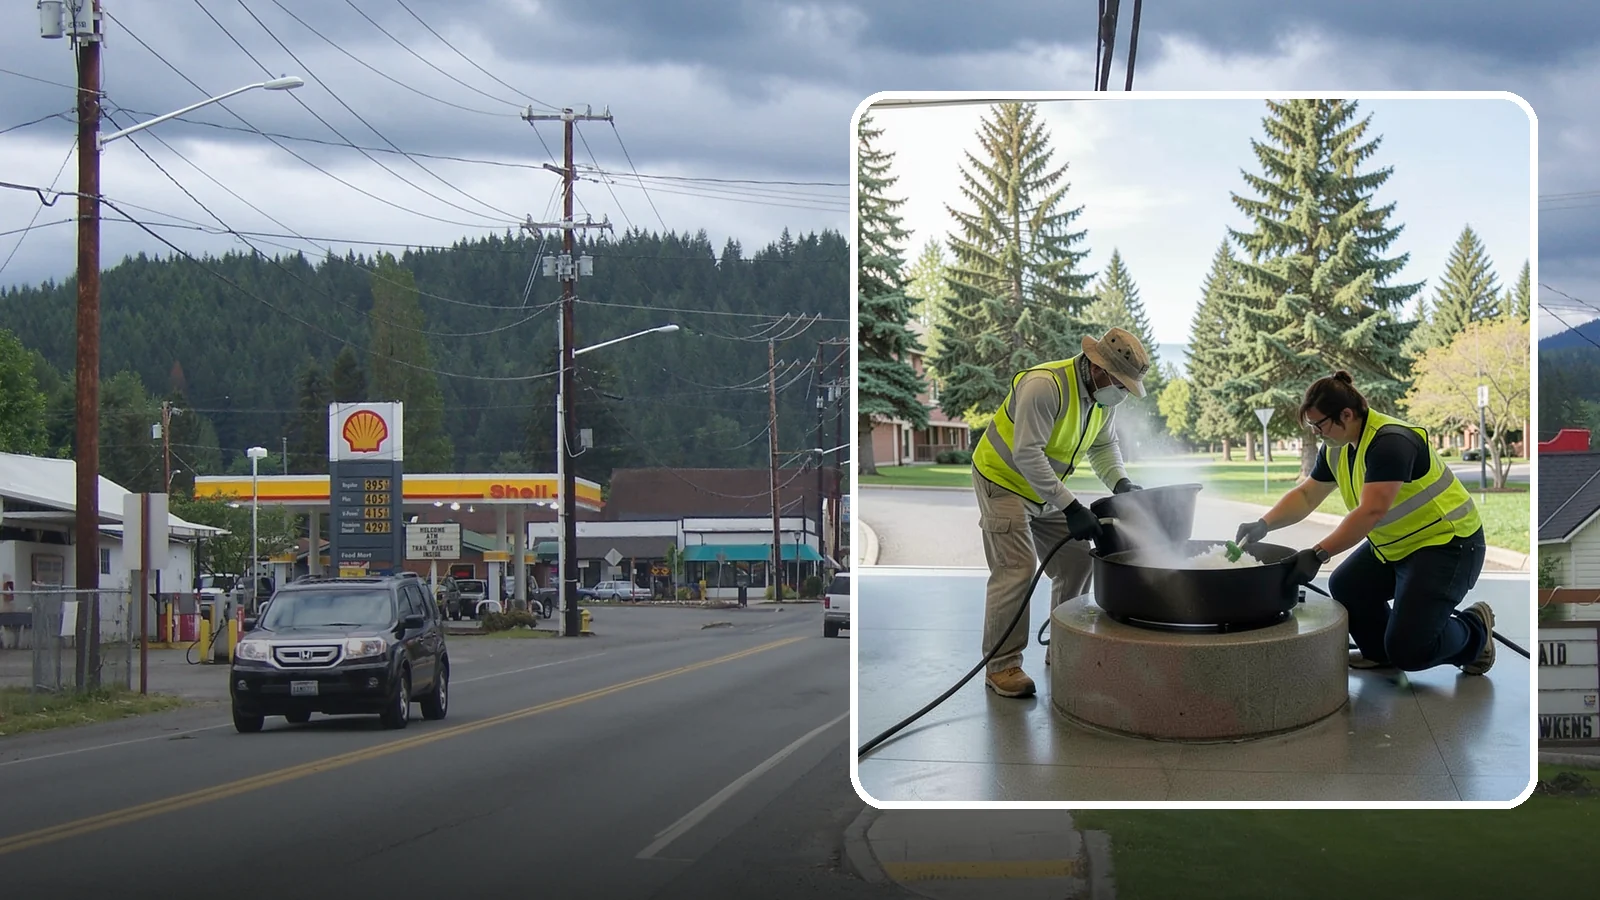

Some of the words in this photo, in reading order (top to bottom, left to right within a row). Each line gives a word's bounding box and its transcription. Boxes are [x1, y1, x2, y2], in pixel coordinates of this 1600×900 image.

[366, 480, 383, 490] 395
[490, 484, 547, 499] Shell
[366, 494, 383, 504] 405
[366, 508, 383, 518] 415
[366, 522, 383, 532] 429
[1538, 643, 1567, 666] AID
